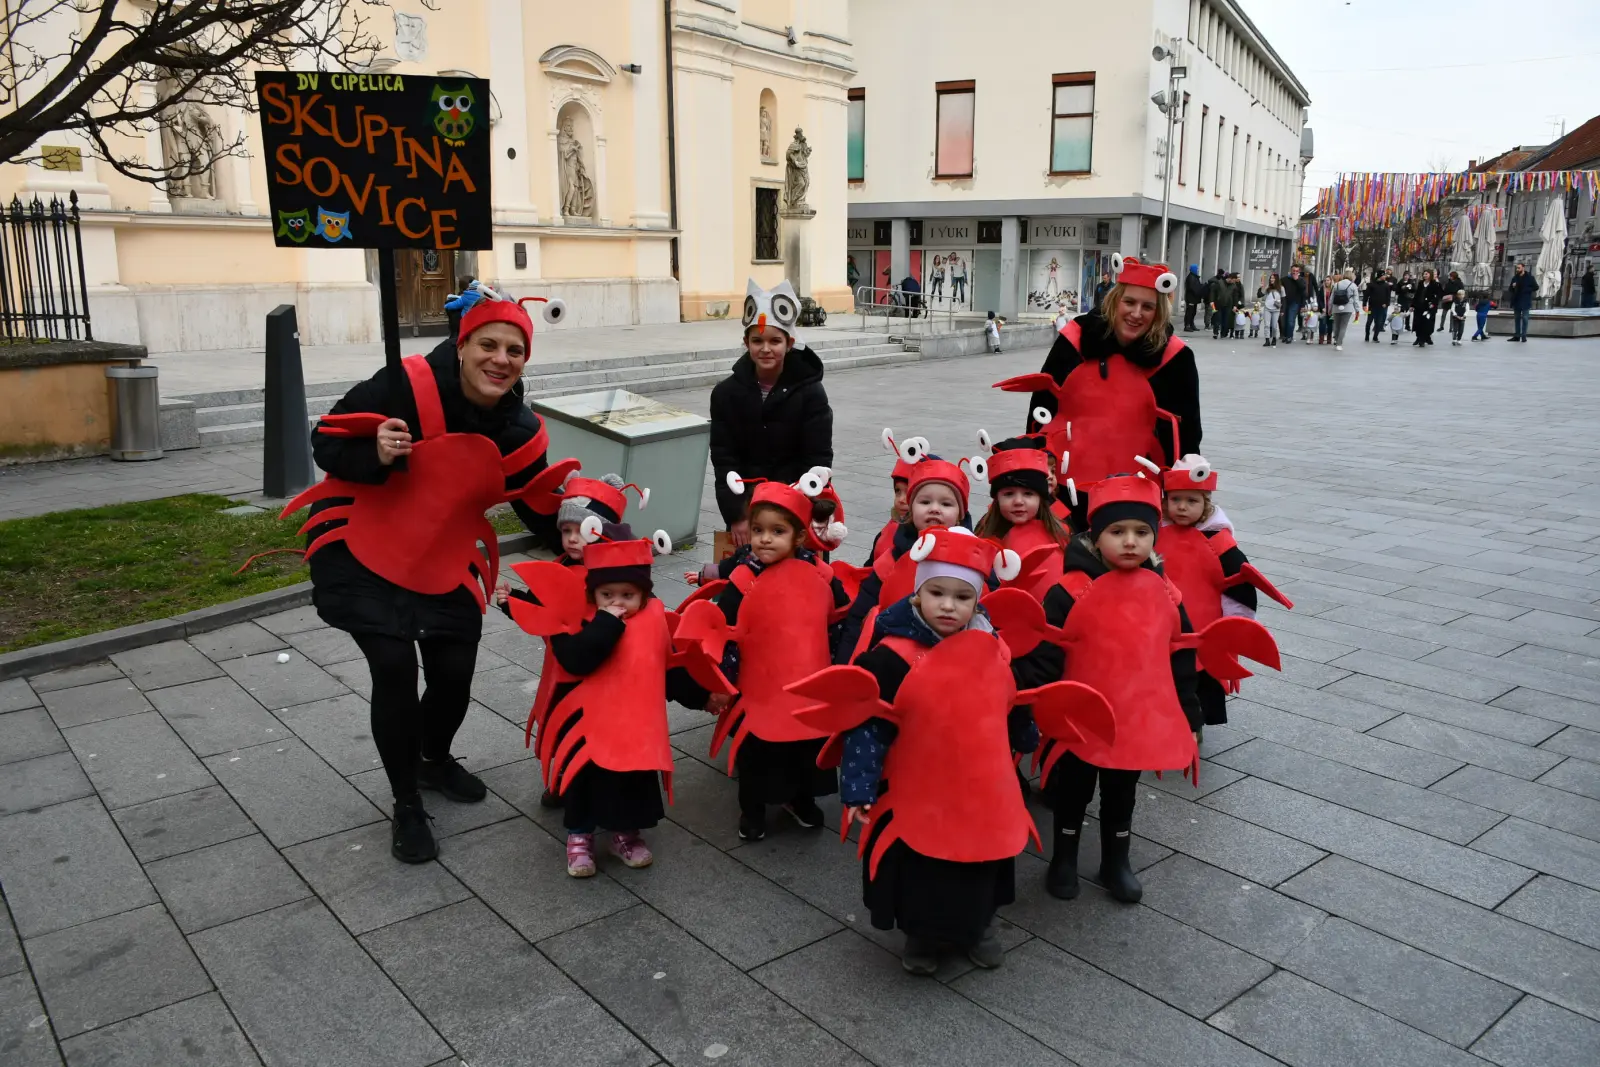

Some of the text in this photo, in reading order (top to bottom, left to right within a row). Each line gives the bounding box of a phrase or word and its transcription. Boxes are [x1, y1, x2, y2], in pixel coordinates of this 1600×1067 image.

[296, 73, 404, 92] DV CIPELICA
[262, 82, 477, 194] SKUPINA
[275, 143, 461, 250] SOVICE
[847, 228, 867, 239] UKI
[938, 224, 969, 238] YUKI
[1044, 224, 1077, 237] YUKI
